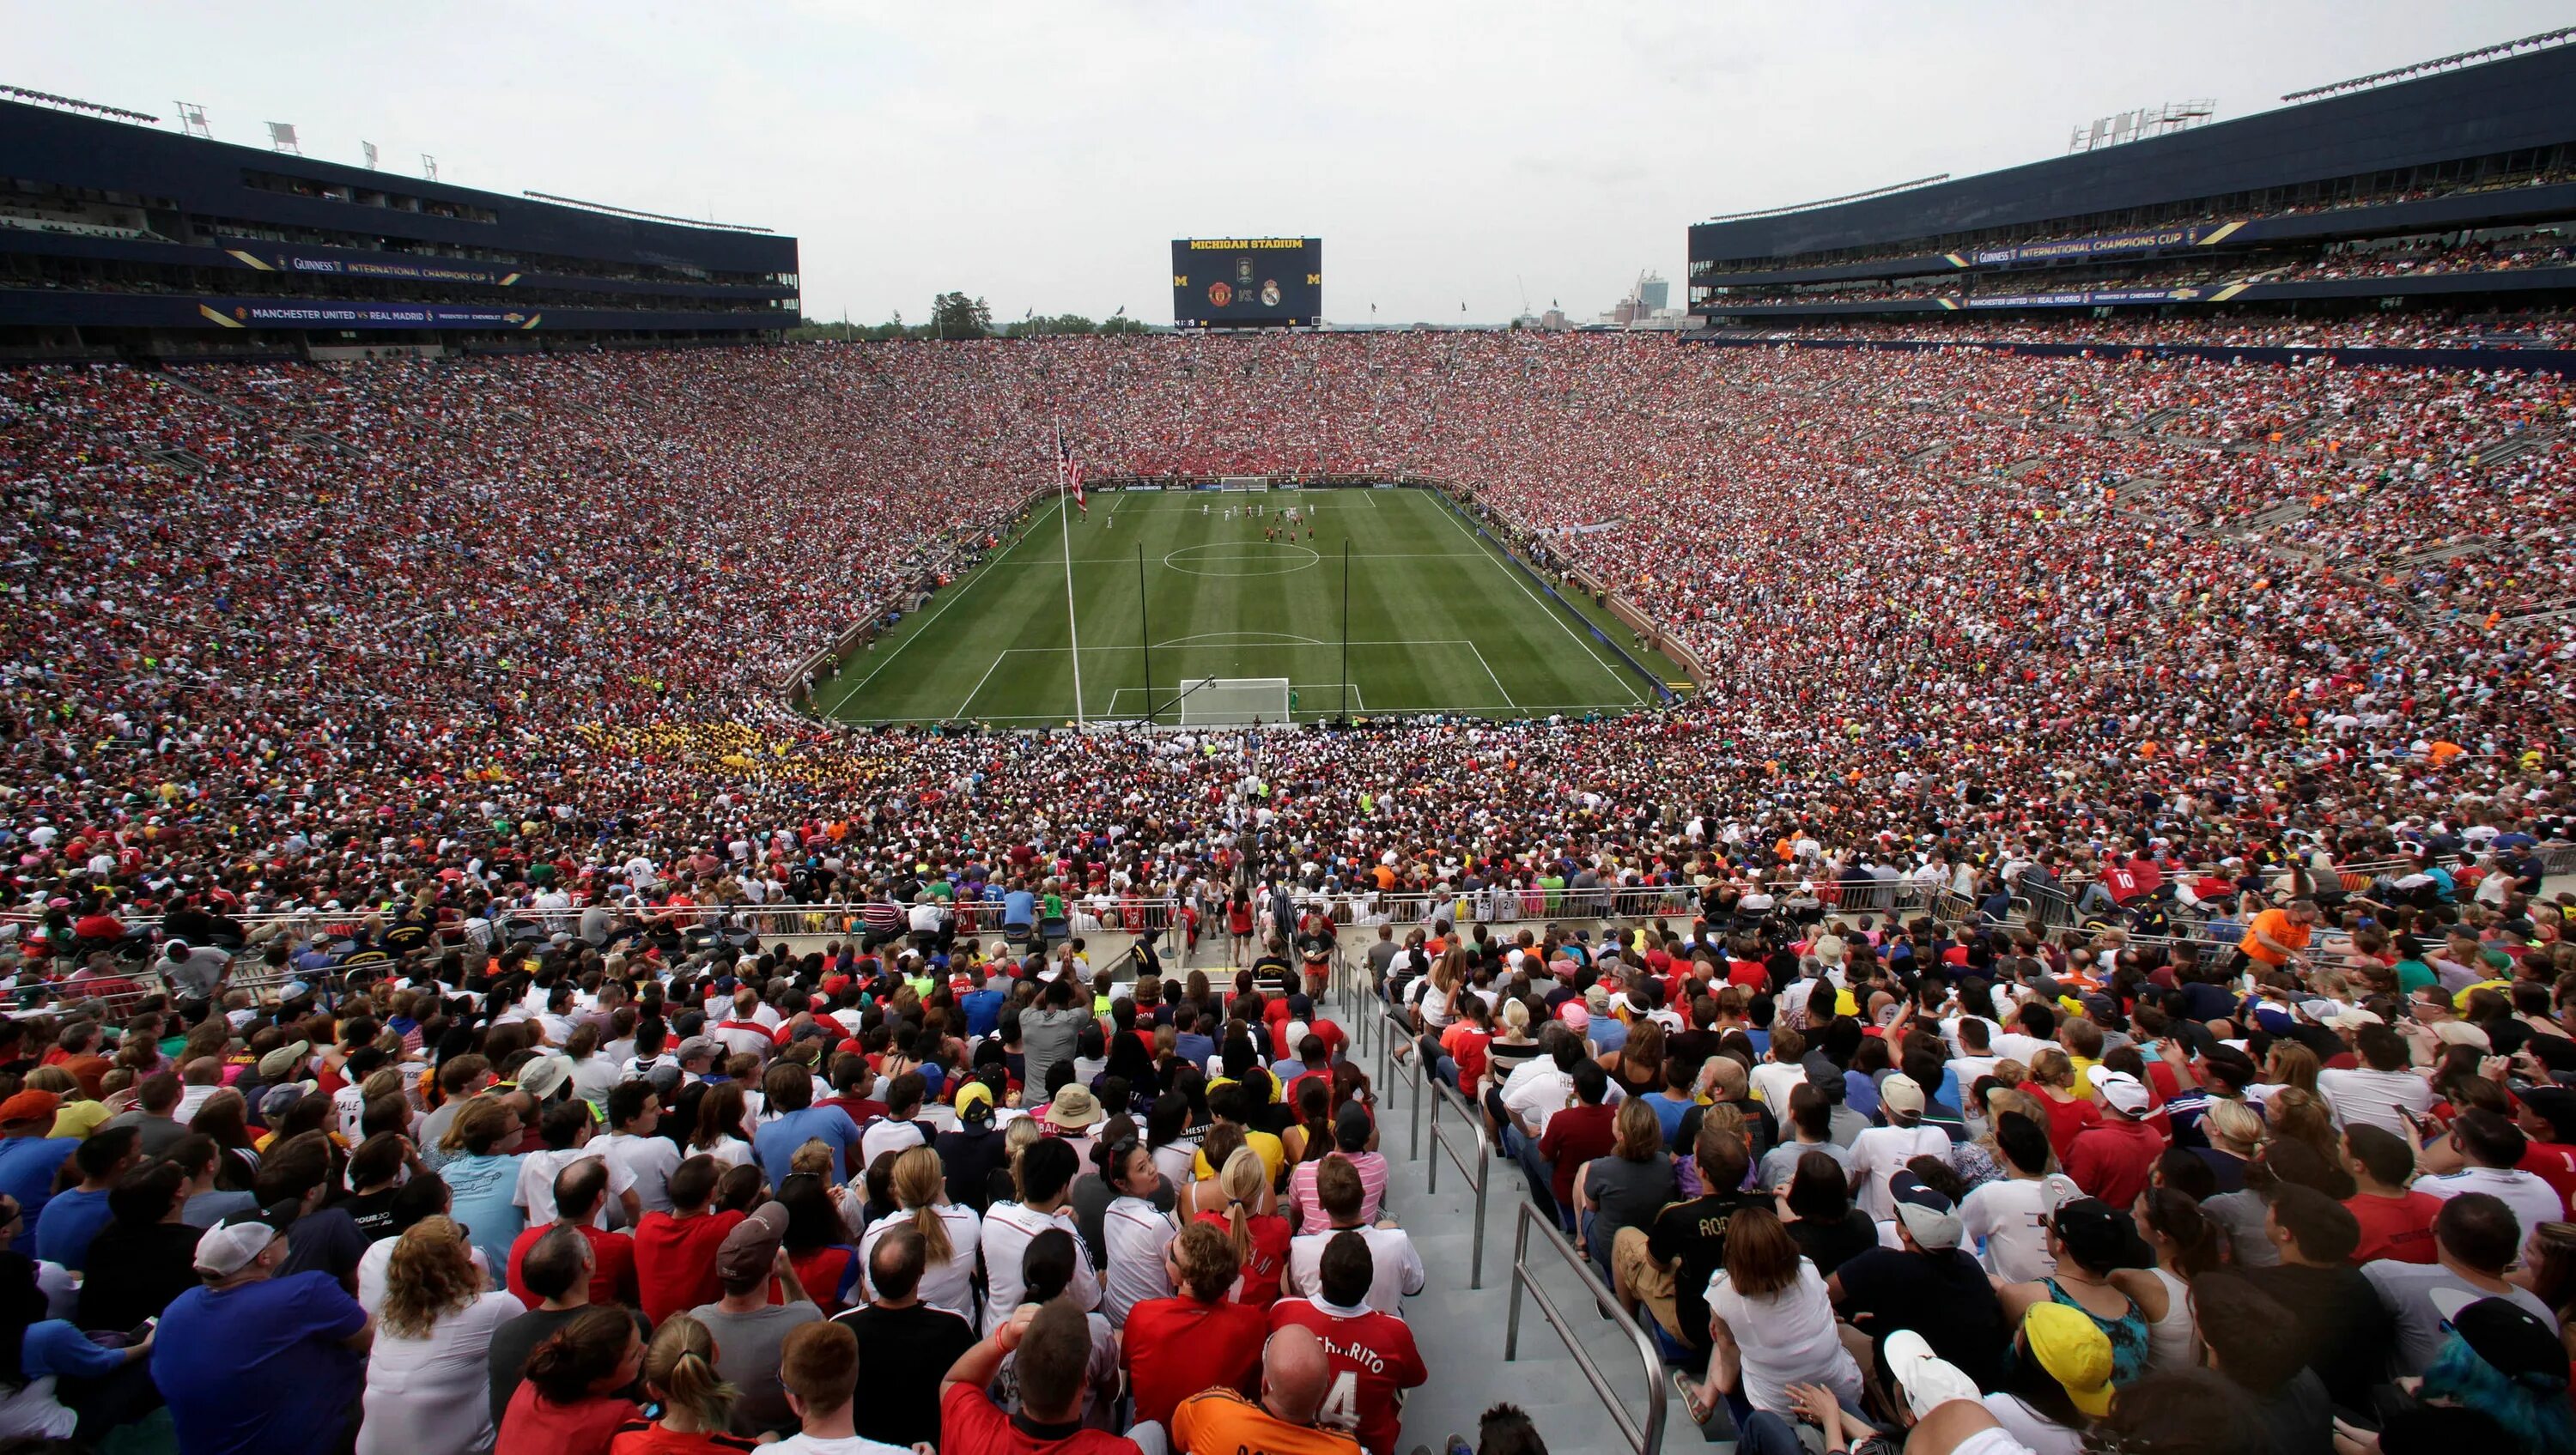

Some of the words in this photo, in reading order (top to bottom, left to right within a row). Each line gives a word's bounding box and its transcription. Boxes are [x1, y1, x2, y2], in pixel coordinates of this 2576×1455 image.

[1190, 239, 1249, 249] MICHIGAN
[1250, 239, 1303, 249] STADIUM
[2020, 242, 2091, 258] INTERNATIONAL
[2093, 235, 2155, 252] CHAMPIONS
[2157, 232, 2184, 245] CUP
[1979, 252, 2009, 263] GUINNESS
[294, 258, 333, 271] GUINNESS
[347, 263, 420, 277] INTERNATIONAL
[422, 270, 470, 282] CHAMPIONS
[1174, 275, 1188, 287] M
[1307, 274, 1321, 285] M
[1970, 298, 2006, 306] MANCHESTER
[2006, 297, 2027, 306] UNITED
[252, 309, 321, 319] MANCHESTER
[322, 310, 355, 319] UNITED
[357, 311, 368, 319] VS
[370, 311, 392, 320] REAL
[392, 312, 424, 320] MADRID
[2117, 874, 2135, 888] 10
[1040, 1124, 1060, 1134] BAL
[1316, 1337, 1384, 1374] HRITO
